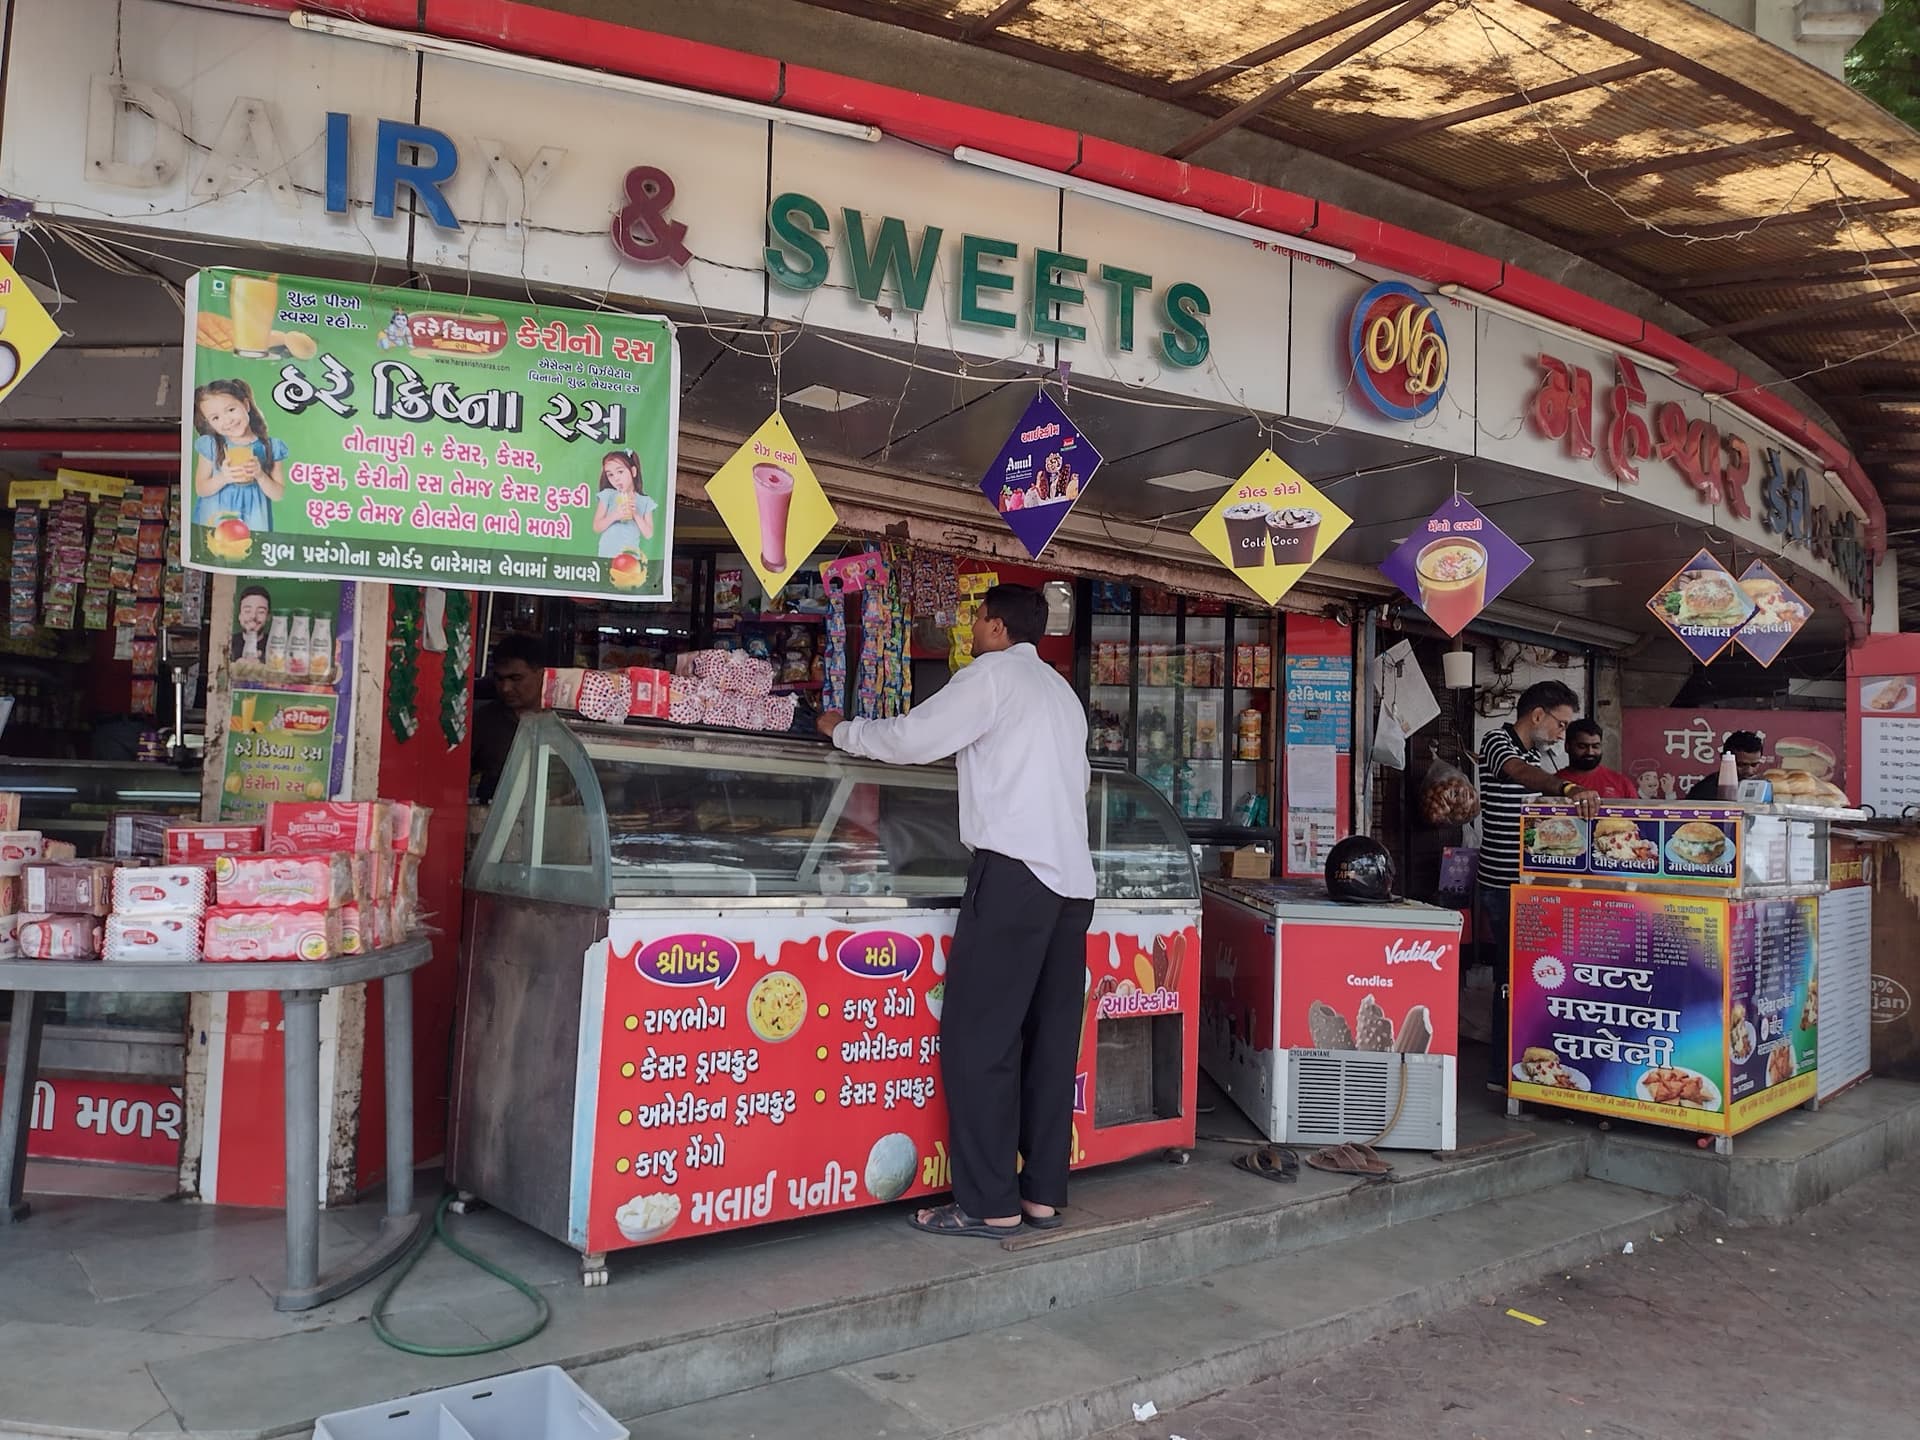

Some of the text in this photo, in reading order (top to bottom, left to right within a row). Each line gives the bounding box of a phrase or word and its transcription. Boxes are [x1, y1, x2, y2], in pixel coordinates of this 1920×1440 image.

[610, 166, 693, 268] &
[764, 192, 1211, 369] SWEETS
[279, 310, 319, 325] સ્વસ્થ
[323, 296, 361, 310] પીઓ
[517, 317, 655, 364] કેરીનો રસ
[576, 362, 584, 374] કે
[272, 352, 358, 418] હરે
[539, 392, 626, 444] રસ
[625, 384, 640, 393] રસ
[344, 425, 416, 463] તોતાપુરી
[442, 435, 488, 468] કેસર,
[497, 442, 542, 473] કેસર,
[754, 441, 797, 465] રોઝ લસ્સી
[1006, 454, 1031, 472] Amul
[356, 462, 410, 491] કેરીનો
[417, 475, 442, 494] રસ
[451, 471, 493, 498] તેમજ
[501, 475, 540, 502] કેસર
[545, 484, 590, 512] ટુકડી
[1239, 482, 1301, 498] કોલ્ડ કોકો
[307, 496, 571, 539] છૂટક તેમજ હોલસેલ ભાવે મળશે
[1453, 518, 1482, 531] લસ્સી
[1242, 535, 1299, 548] Cold Coco
[262, 540, 600, 583] શુભ પ્રસંગોના ઓર્ડર બારેમાસ લેવામાં આવશે
[300, 747, 323, 760] રસ
[656, 941, 720, 975] શ્રીખંડ
[865, 938, 897, 967] મઠો
[1385, 938, 1446, 970] Vadilal
[1347, 974, 1393, 987] Candies
[1572, 963, 1653, 992] बटर
[643, 997, 726, 1034] રાજભોગ
[843, 988, 915, 1029] કાજુ મેંગો
[1547, 995, 1680, 1033] मसाला
[640, 1046, 687, 1081] કેસર
[841, 1031, 912, 1064] અમેરીકન
[1553, 1029, 1673, 1069] दाबेली
[840, 1076, 876, 1107] કેસર
[638, 1091, 727, 1128] અમેરીકન
[635, 1132, 725, 1184] કાજુ મેંગો
[691, 1161, 858, 1225] મલાઈ પનીર
